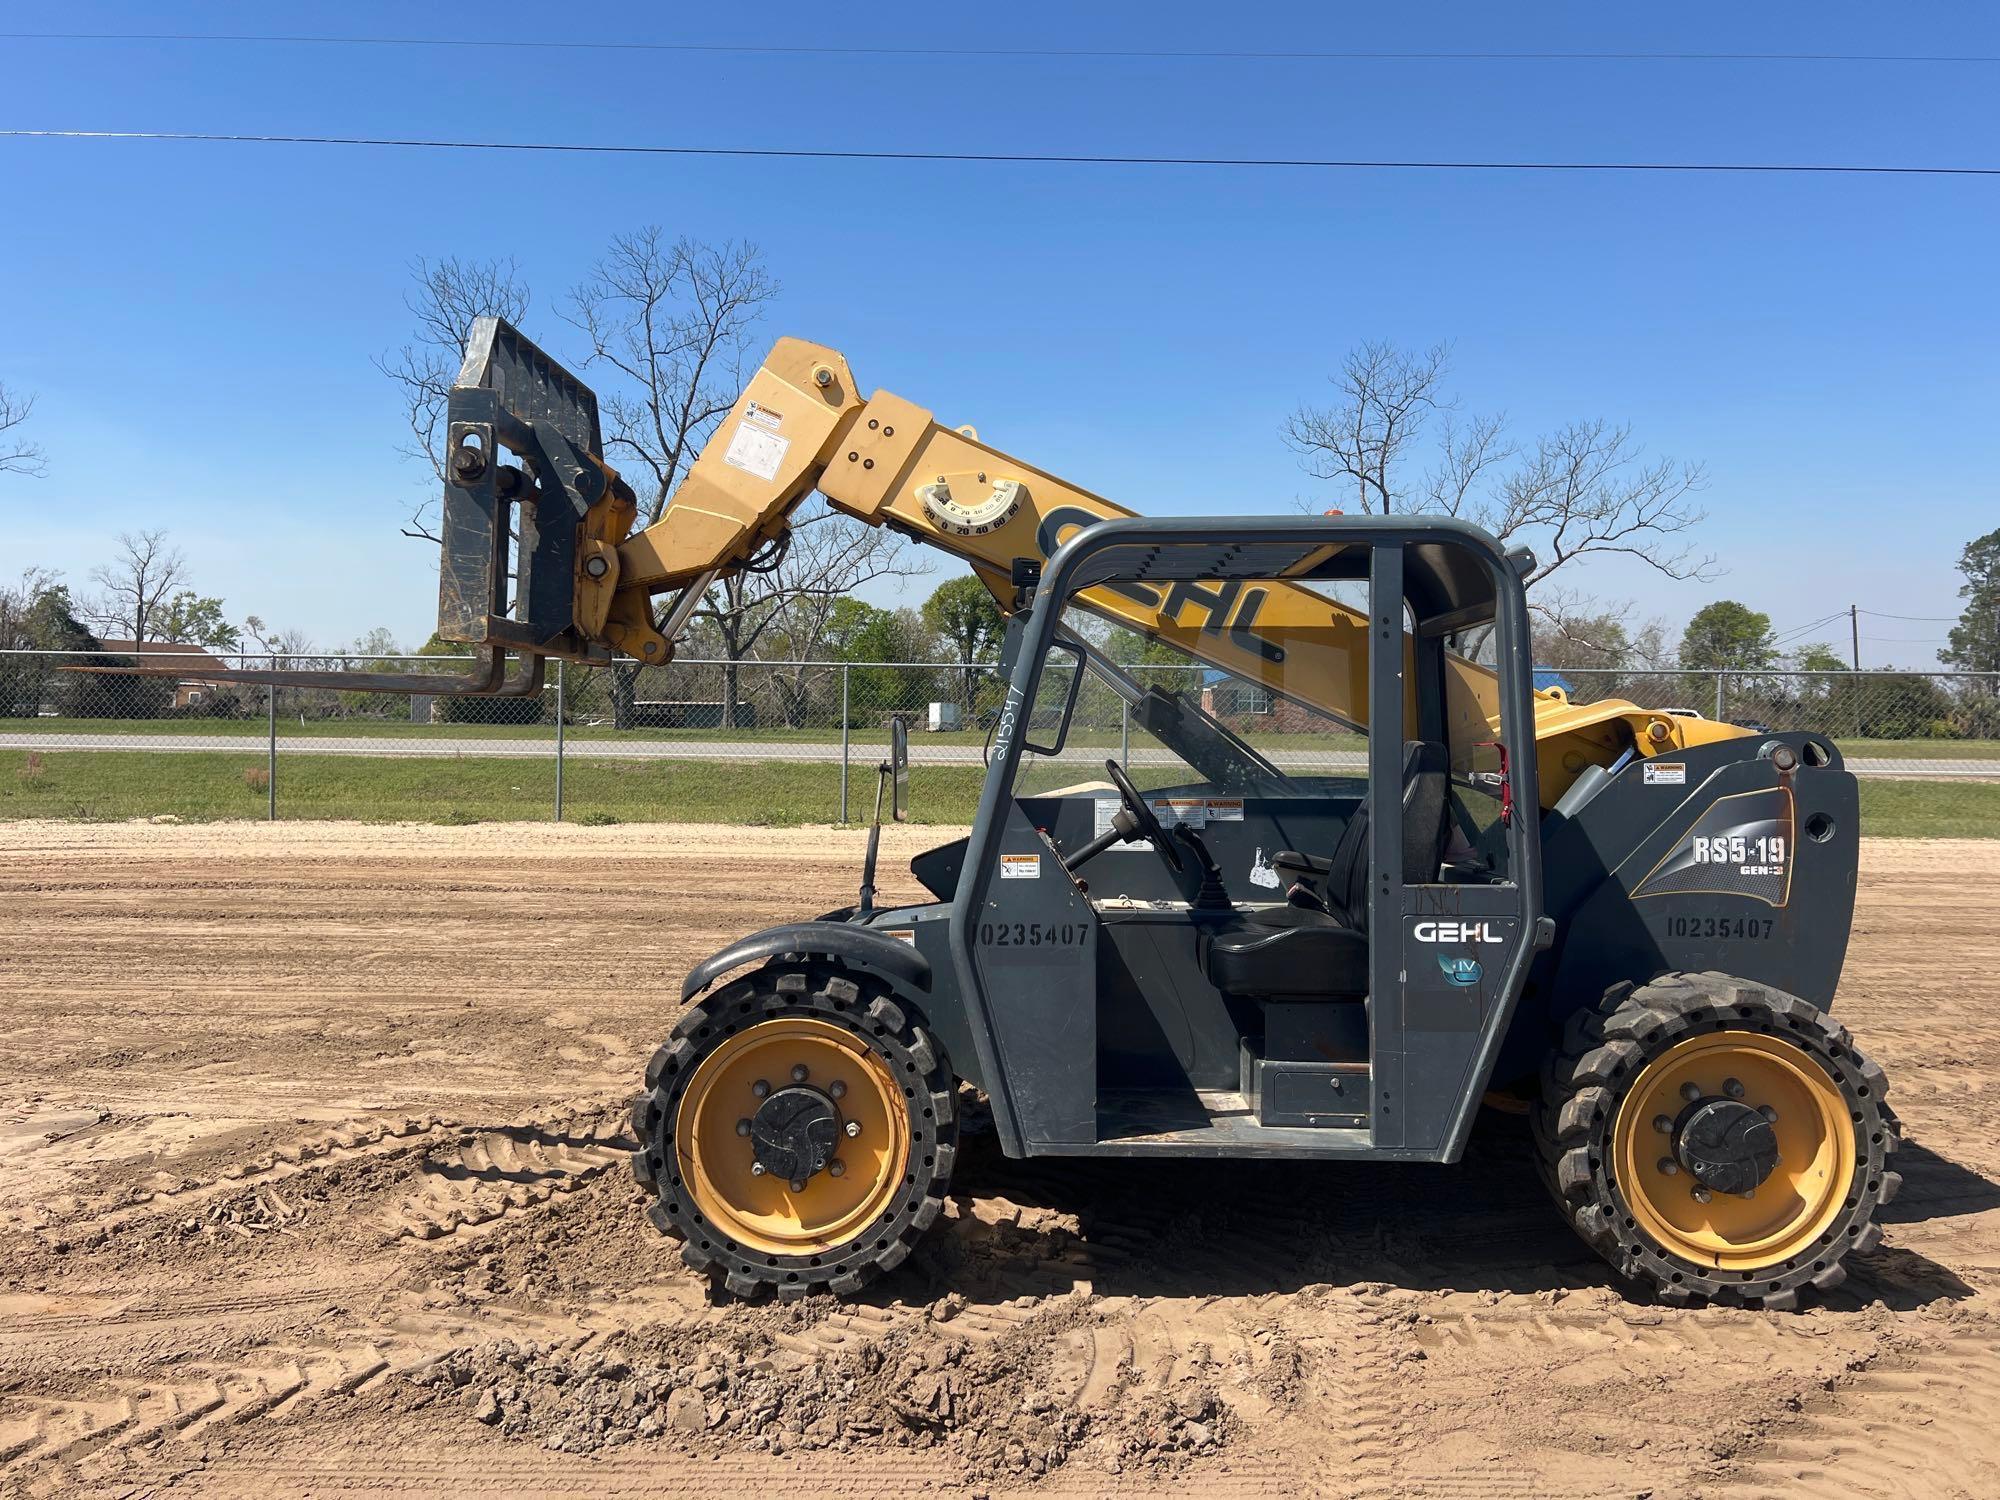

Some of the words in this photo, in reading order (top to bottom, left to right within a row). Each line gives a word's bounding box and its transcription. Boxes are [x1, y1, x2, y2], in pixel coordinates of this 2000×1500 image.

[941, 521, 948, 530] 0
[957, 526, 970, 535] 20
[975, 526, 989, 534] 40
[993, 517, 1006, 529] 60
[992, 684, 1025, 760] 215547
[1693, 836, 1785, 864] RS5-19
[1414, 922, 1503, 943] GEHL
[1668, 917, 1773, 939] 10235407
